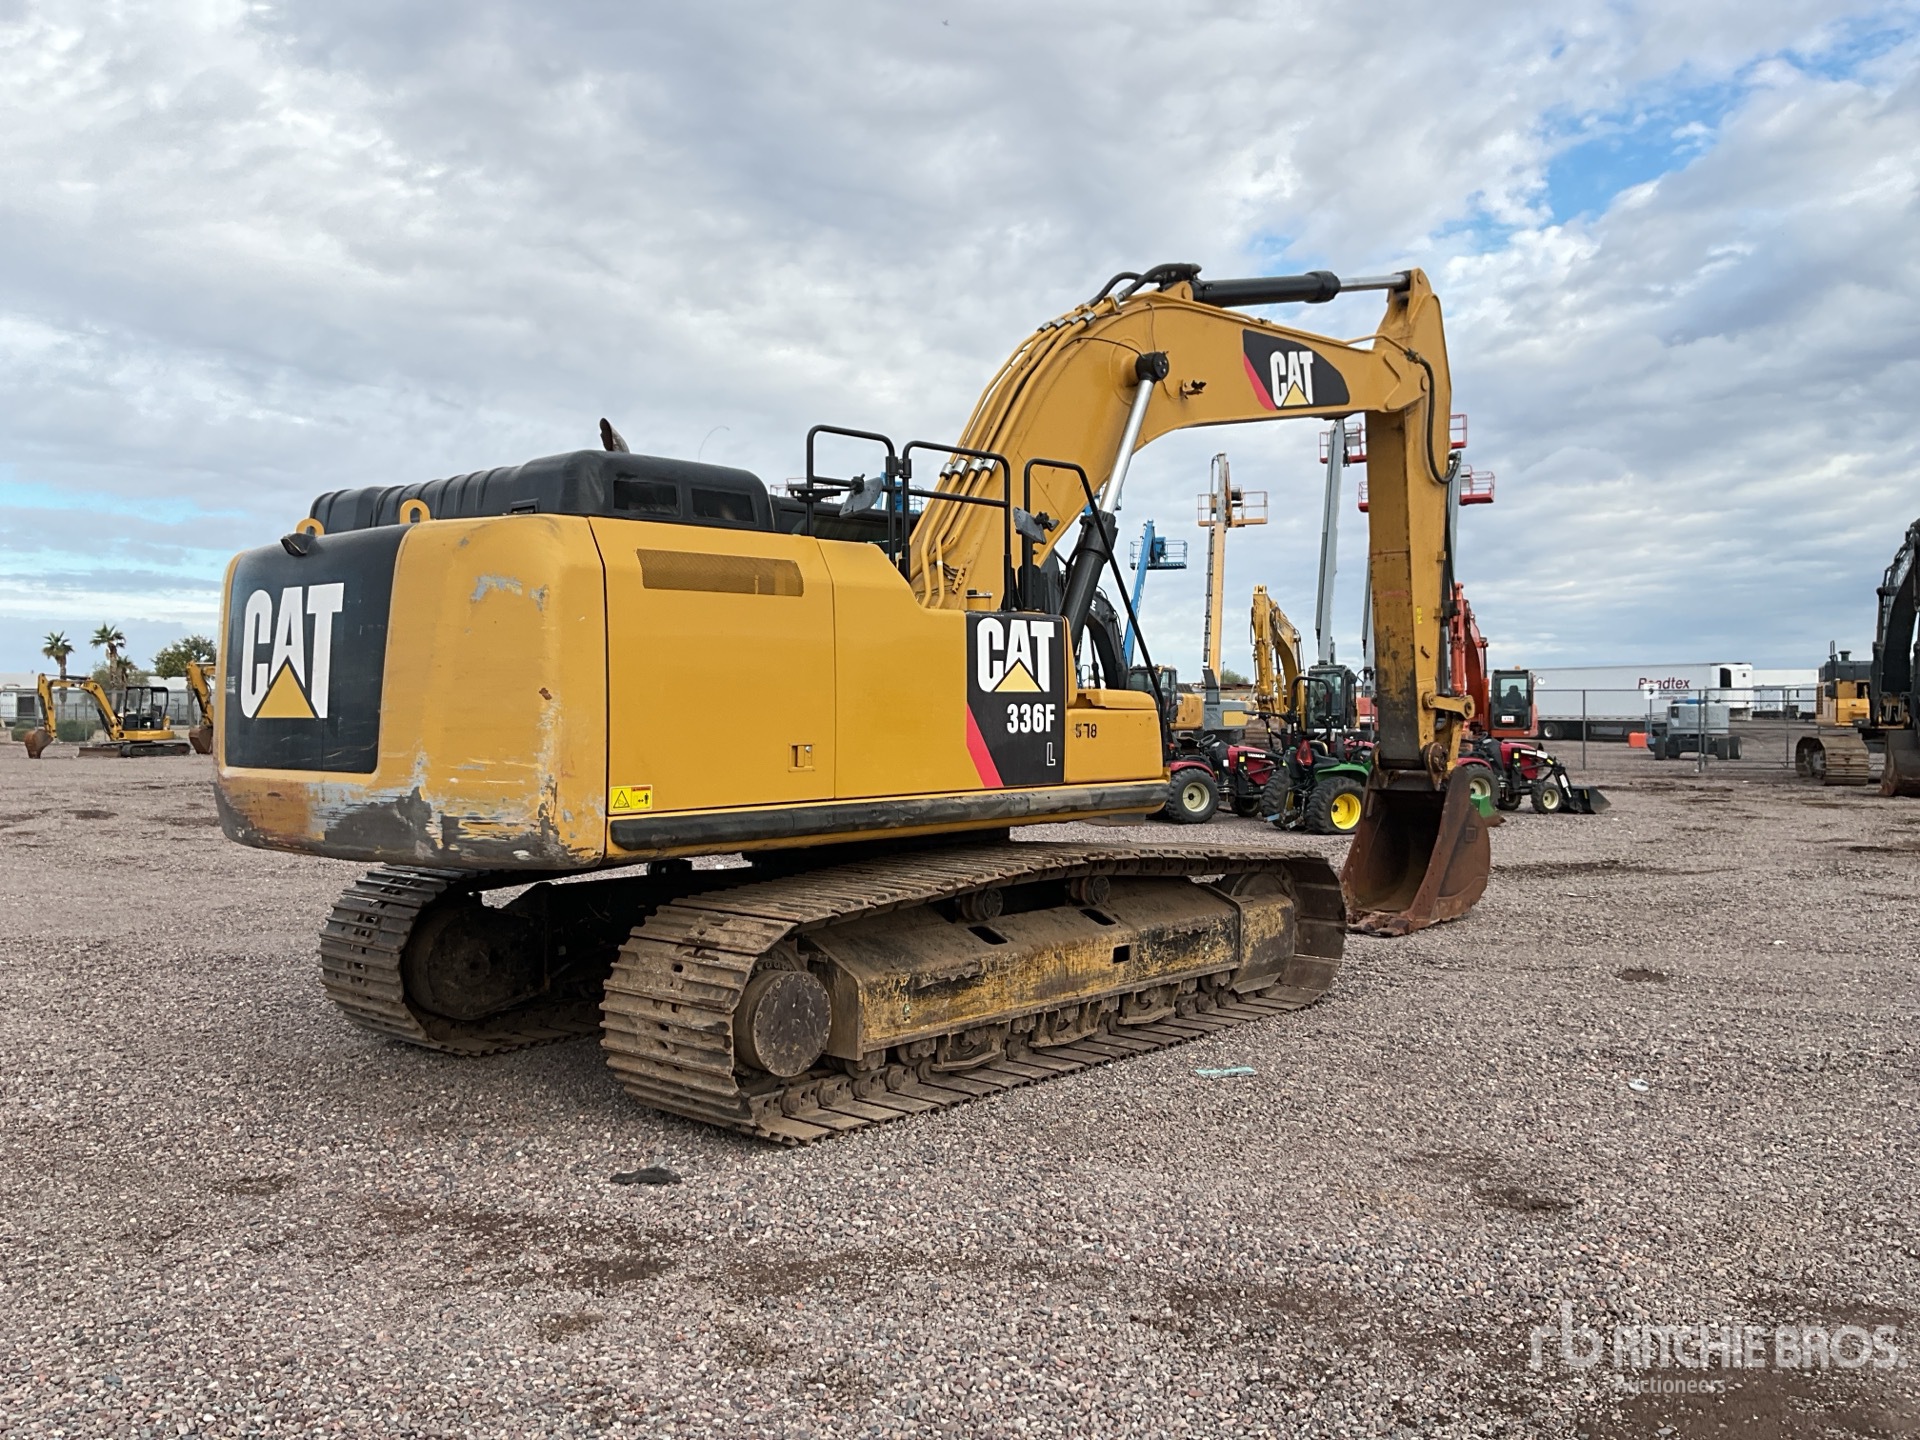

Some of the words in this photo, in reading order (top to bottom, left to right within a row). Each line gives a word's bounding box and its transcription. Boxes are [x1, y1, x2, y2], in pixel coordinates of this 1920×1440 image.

[1269, 350, 1314, 407] CAT
[240, 582, 345, 719] CAT
[976, 617, 1055, 693] CAT
[1638, 677, 1690, 690] Radtex
[1006, 703, 1056, 734] 336F
[1046, 742, 1056, 766] L
